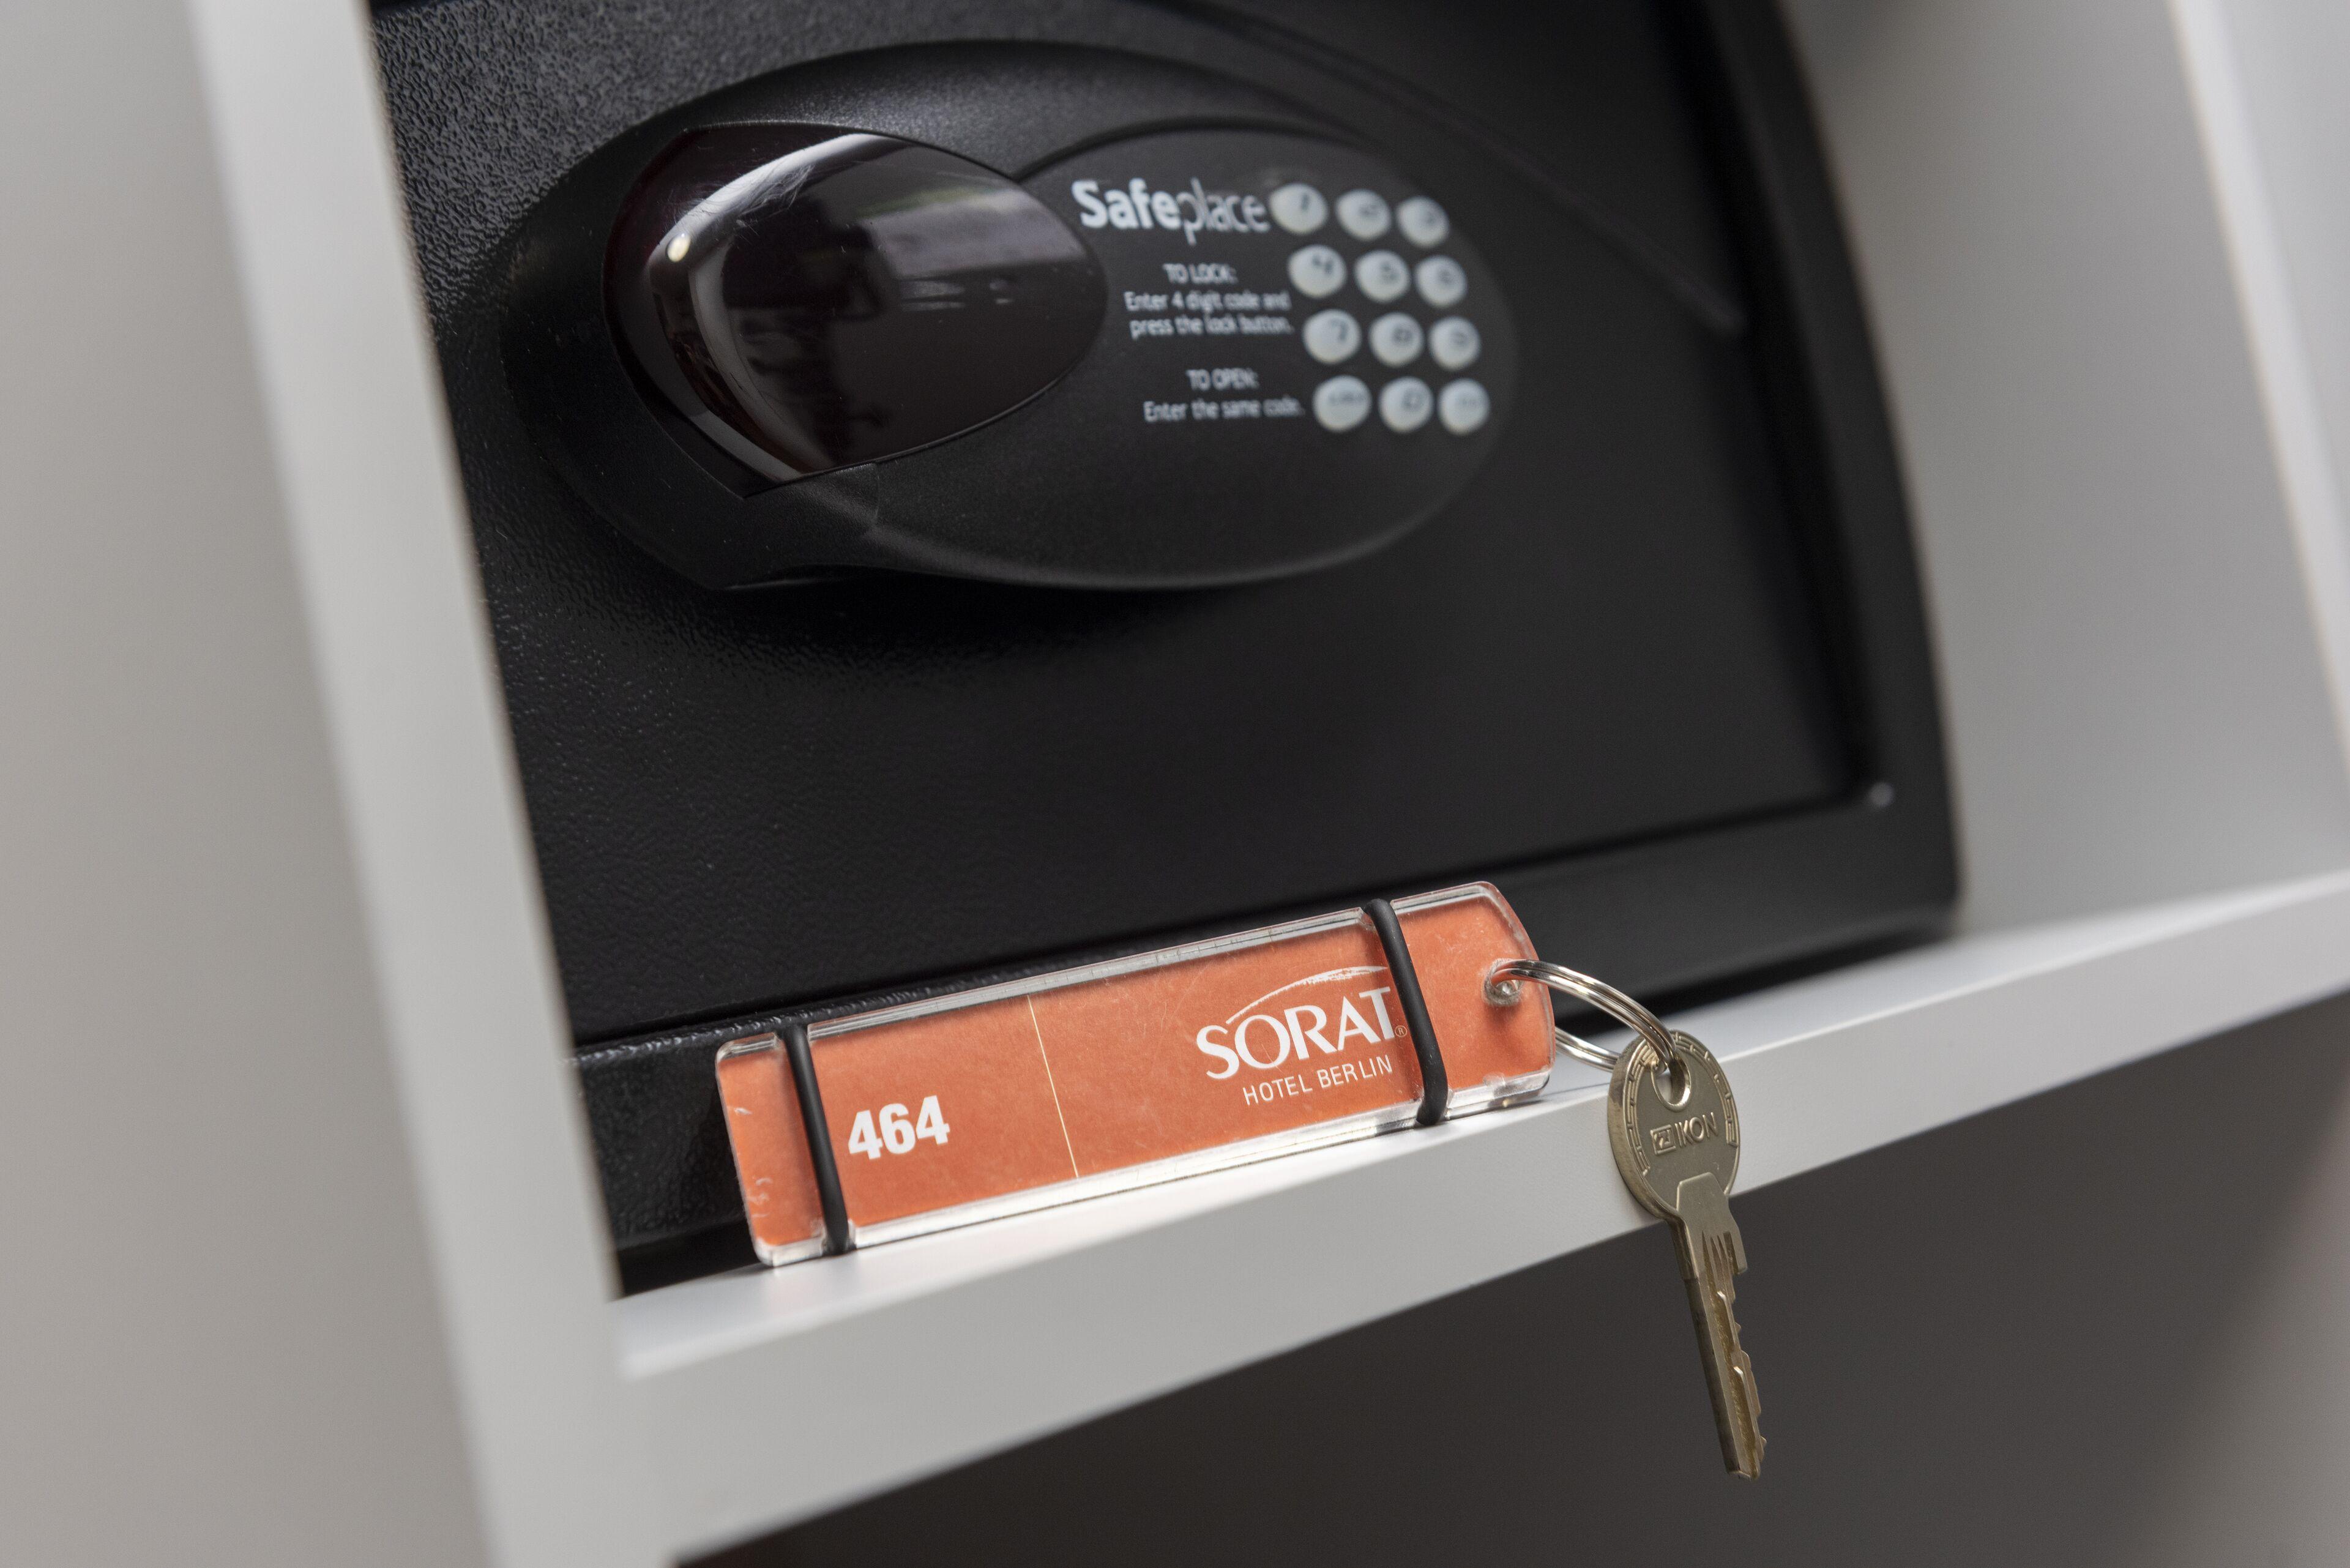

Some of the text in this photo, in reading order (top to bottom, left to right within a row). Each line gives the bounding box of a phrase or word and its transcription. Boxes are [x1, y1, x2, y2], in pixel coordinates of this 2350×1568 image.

[1072, 177, 1270, 245] Safeplace
[1163, 263, 1188, 283] TO
[1124, 291, 1168, 311] Enter
[1172, 291, 1184, 308] 4
[1130, 318, 1174, 340] press
[1186, 368, 1211, 390] TO
[1143, 400, 1188, 422] Enter
[1242, 1054, 1393, 1106] HOTEL BERLIN
[848, 1095, 950, 1160] 464
